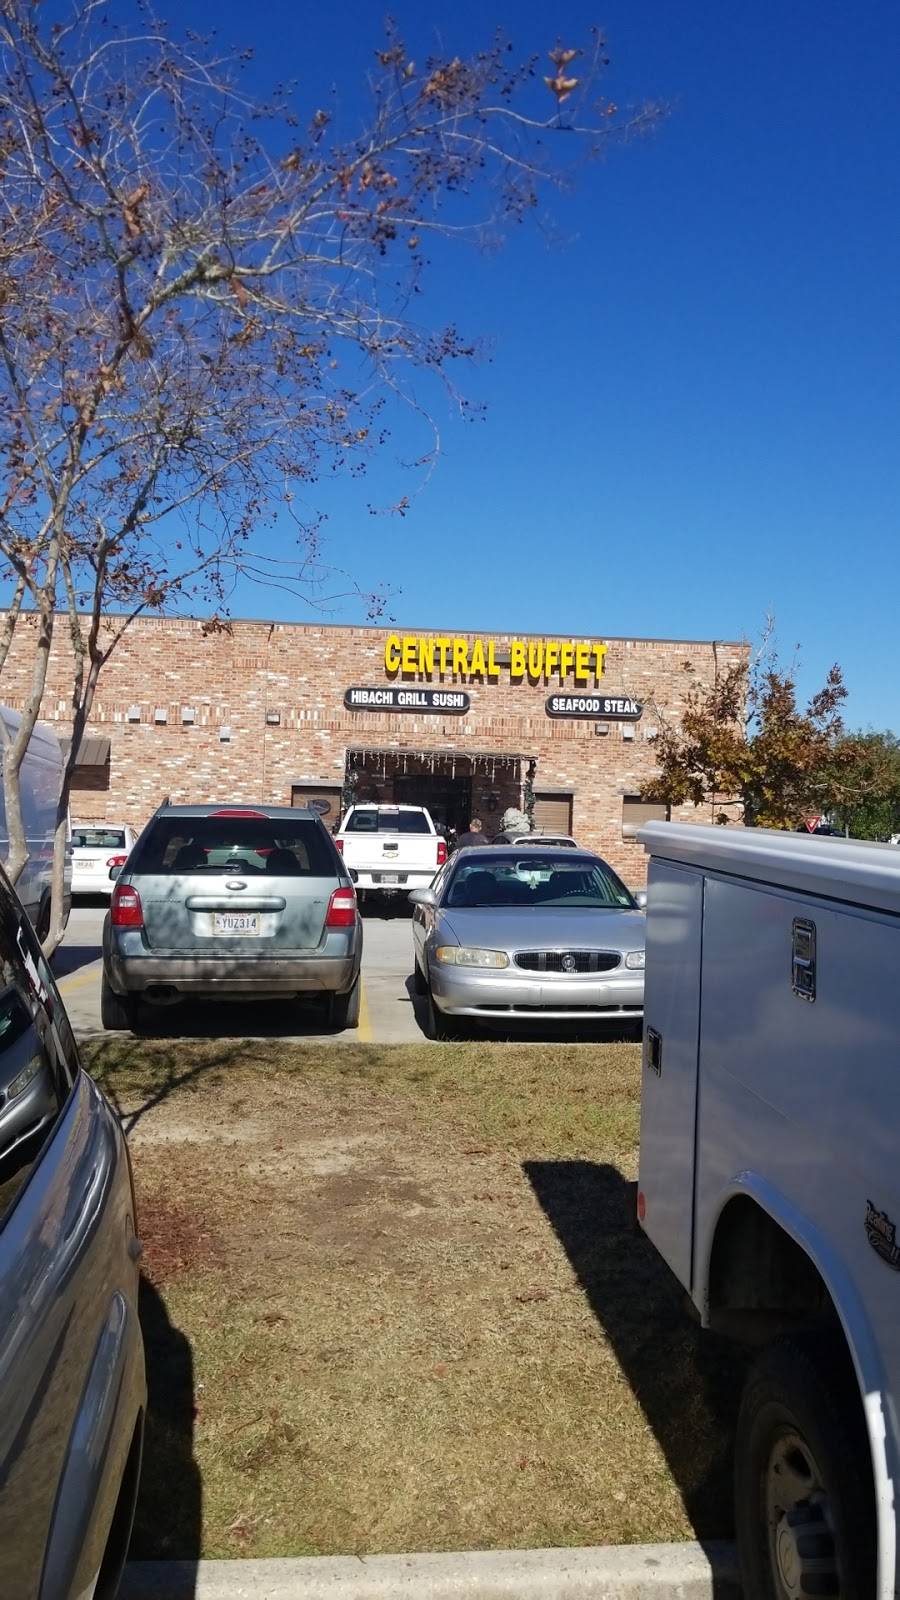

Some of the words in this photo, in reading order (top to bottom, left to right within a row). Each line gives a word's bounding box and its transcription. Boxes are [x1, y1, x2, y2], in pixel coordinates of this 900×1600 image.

[384, 635, 500, 676] CENTRAL
[510, 640, 608, 680] BUFFET
[351, 690, 393, 704] HIBACHI
[397, 692, 428, 705] GRILL
[432, 693, 464, 707] SUSHI
[552, 698, 600, 712] SEAFOOD
[604, 699, 638, 713] STEAK
[222, 918, 257, 929] YUZ314
